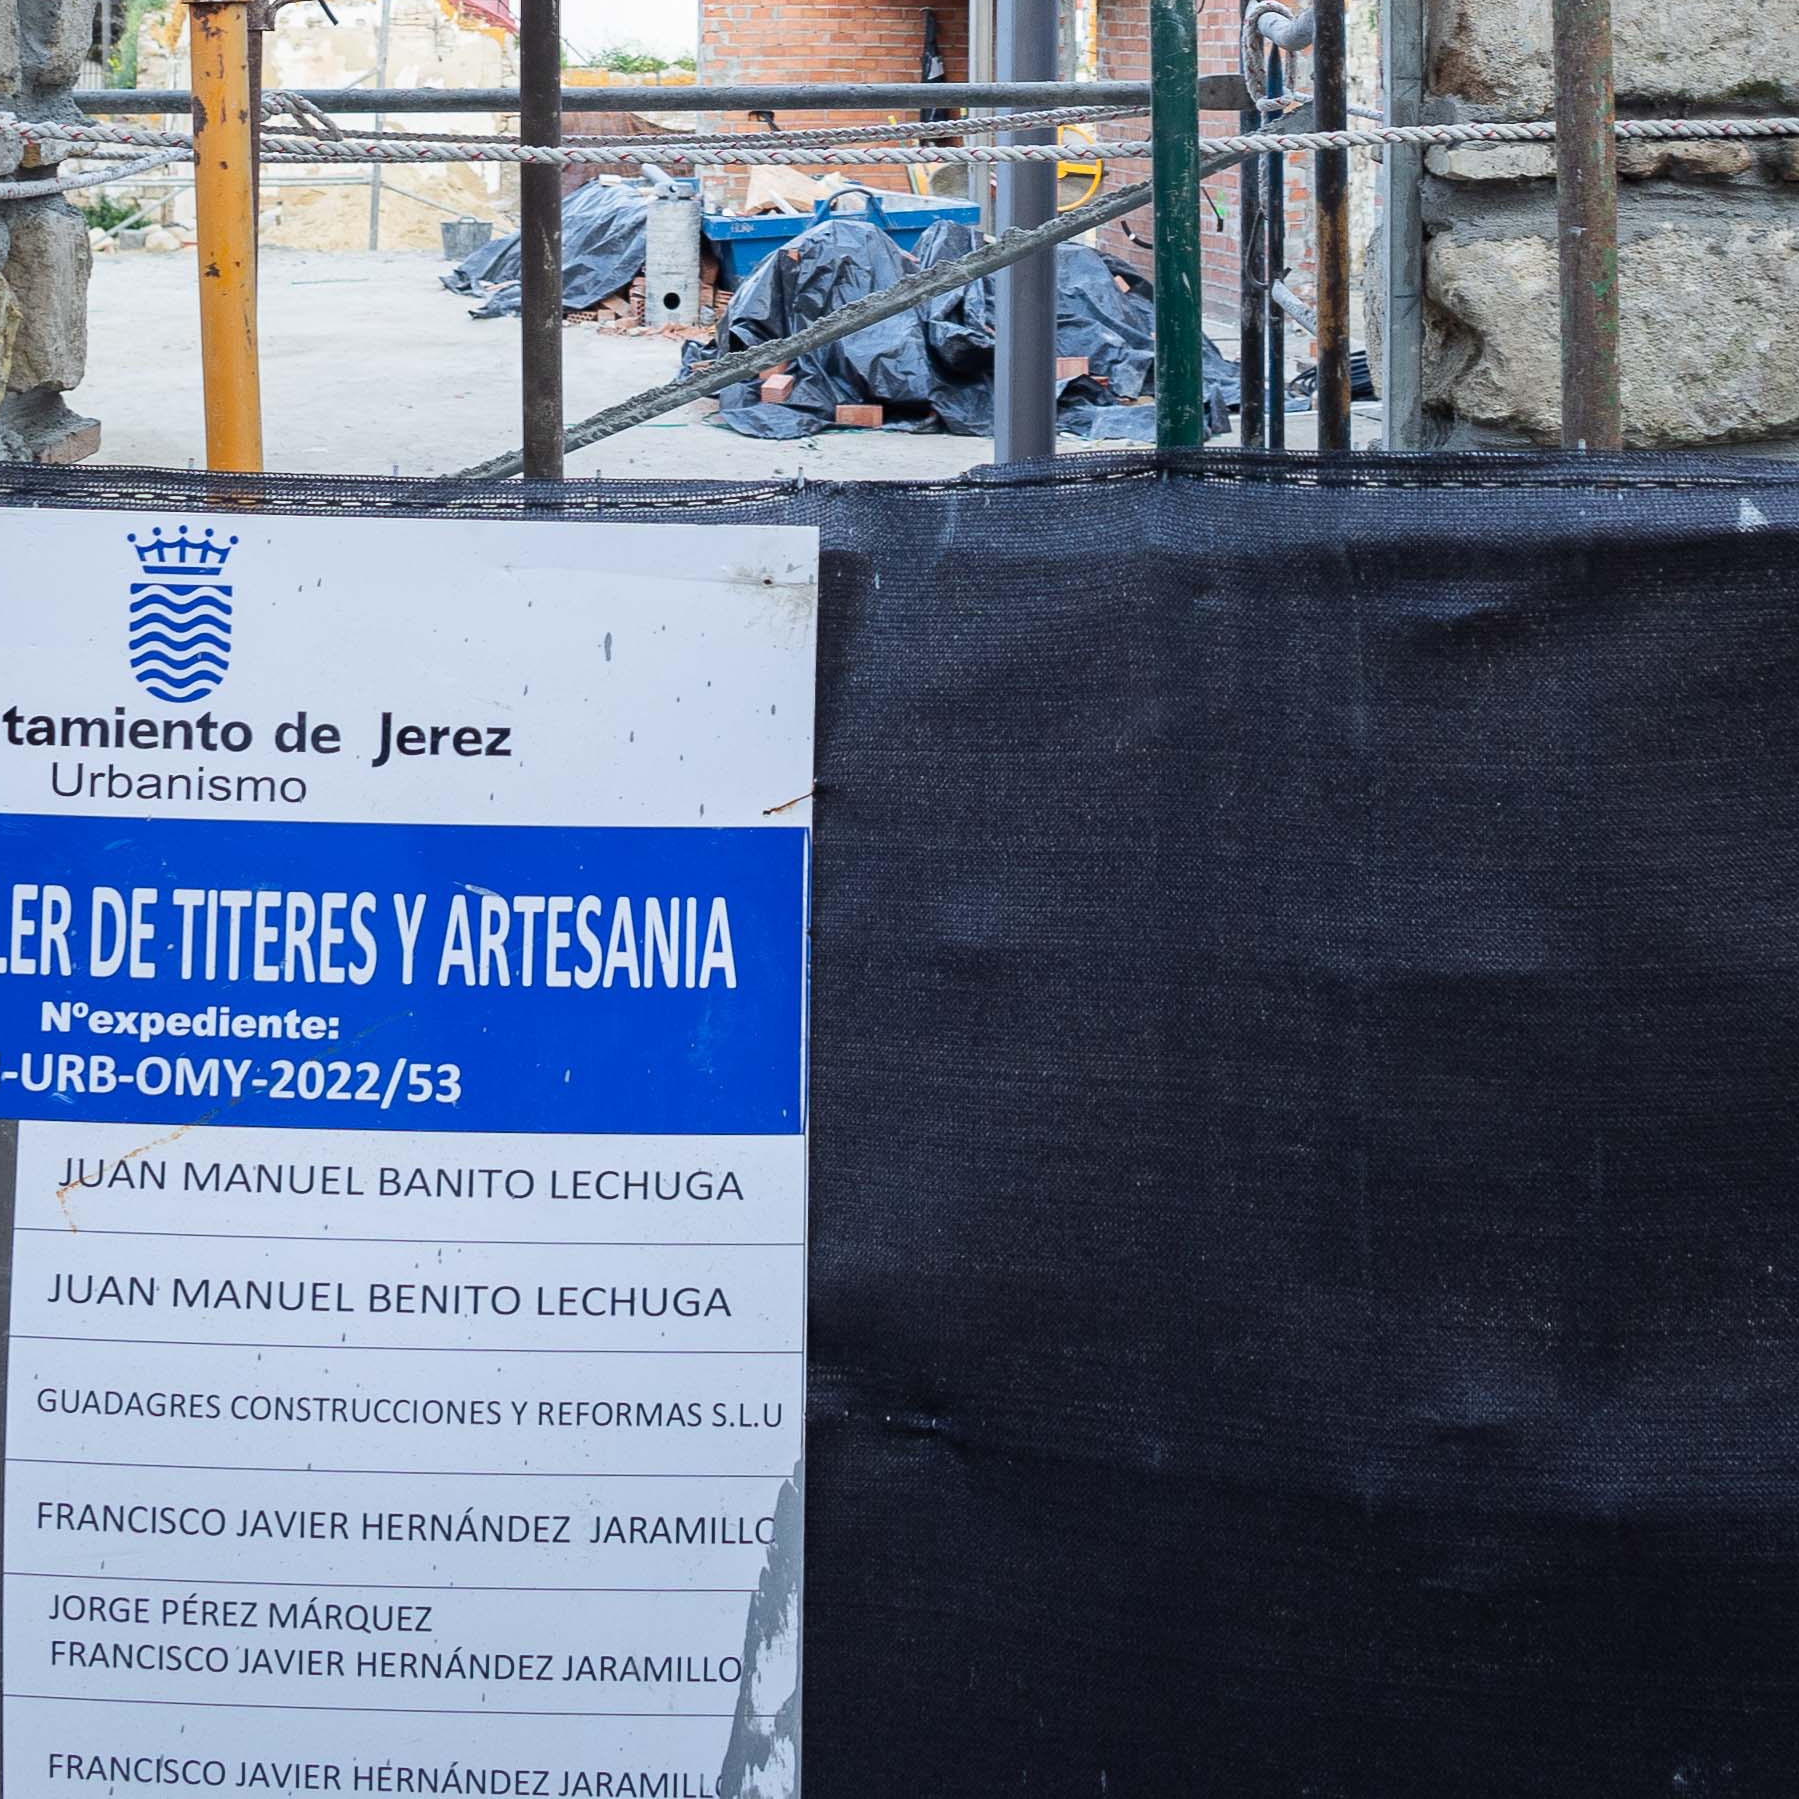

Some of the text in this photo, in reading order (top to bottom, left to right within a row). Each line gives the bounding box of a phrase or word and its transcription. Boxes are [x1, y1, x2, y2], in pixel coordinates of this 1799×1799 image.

[274, 711, 341, 754] de
[371, 711, 512, 768] Jerez
[51, 761, 307, 803] Urbanismo
[89, 886, 159, 979] DE
[172, 888, 378, 985] TITERES
[393, 892, 427, 986] Y
[437, 894, 738, 990] ARTESANIA
[58, 1157, 745, 1201] JUAN MANUEL BANITO LECHUGA
[47, 1273, 733, 1318] JUAN MANUEL BENITO LECHUGA
[36, 1387, 784, 1429] GUADAGRES CONSTRUCCIONES Y REFORMAS S.L.U
[37, 1501, 777, 1546] FRANCISCO JAVIER HERNÁNDEZ JARAMILLO
[48, 1592, 433, 1635] JORGE PÉREZ MÁRQUEZ
[51, 1640, 743, 1683] FRANCISCO JAVIER HERNÁNDEZ JARAMILLO
[48, 1753, 227, 1786] FRANCISCO
[235, 1760, 342, 1792] JAVIER
[353, 1760, 551, 1798] HERNÁNDEZ
